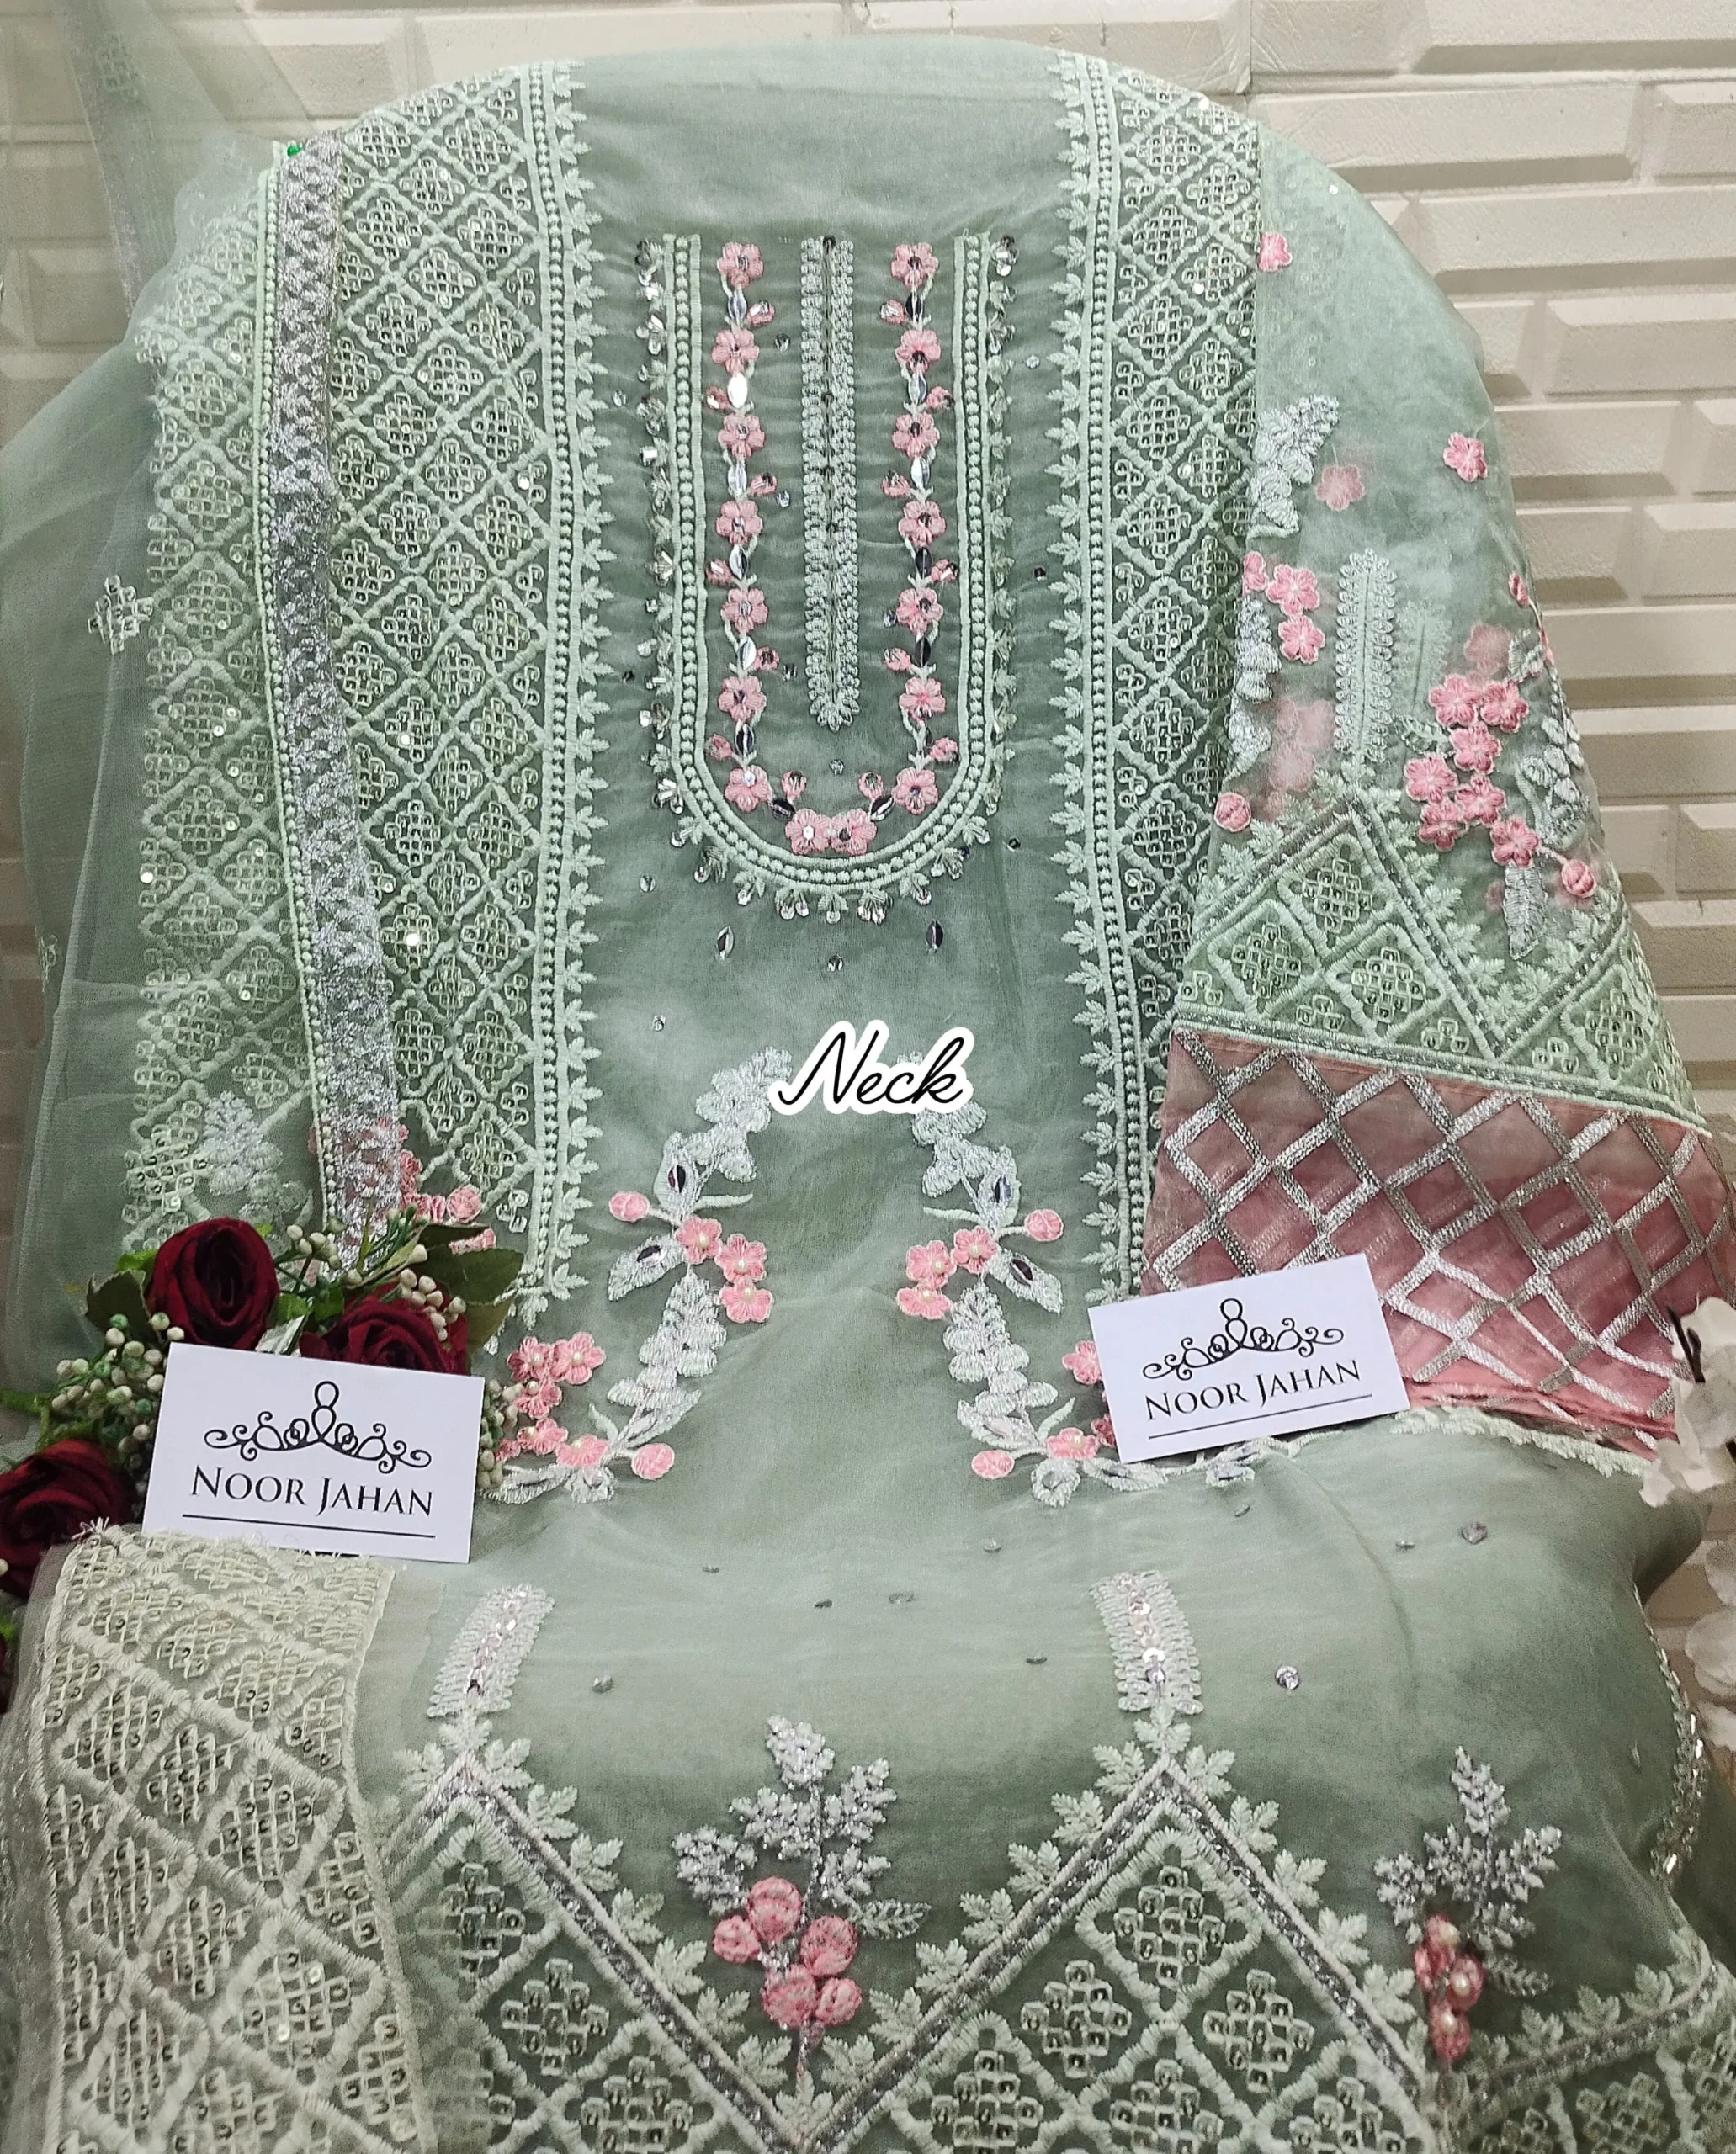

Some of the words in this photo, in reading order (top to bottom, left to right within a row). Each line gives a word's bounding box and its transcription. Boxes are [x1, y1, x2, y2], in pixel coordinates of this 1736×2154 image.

[1144, 1381, 1250, 1421] NOOR
[1254, 1359, 1360, 1409] JAHAN
[190, 1465, 306, 1505] NOOR
[316, 1478, 433, 1516] JAHAN
